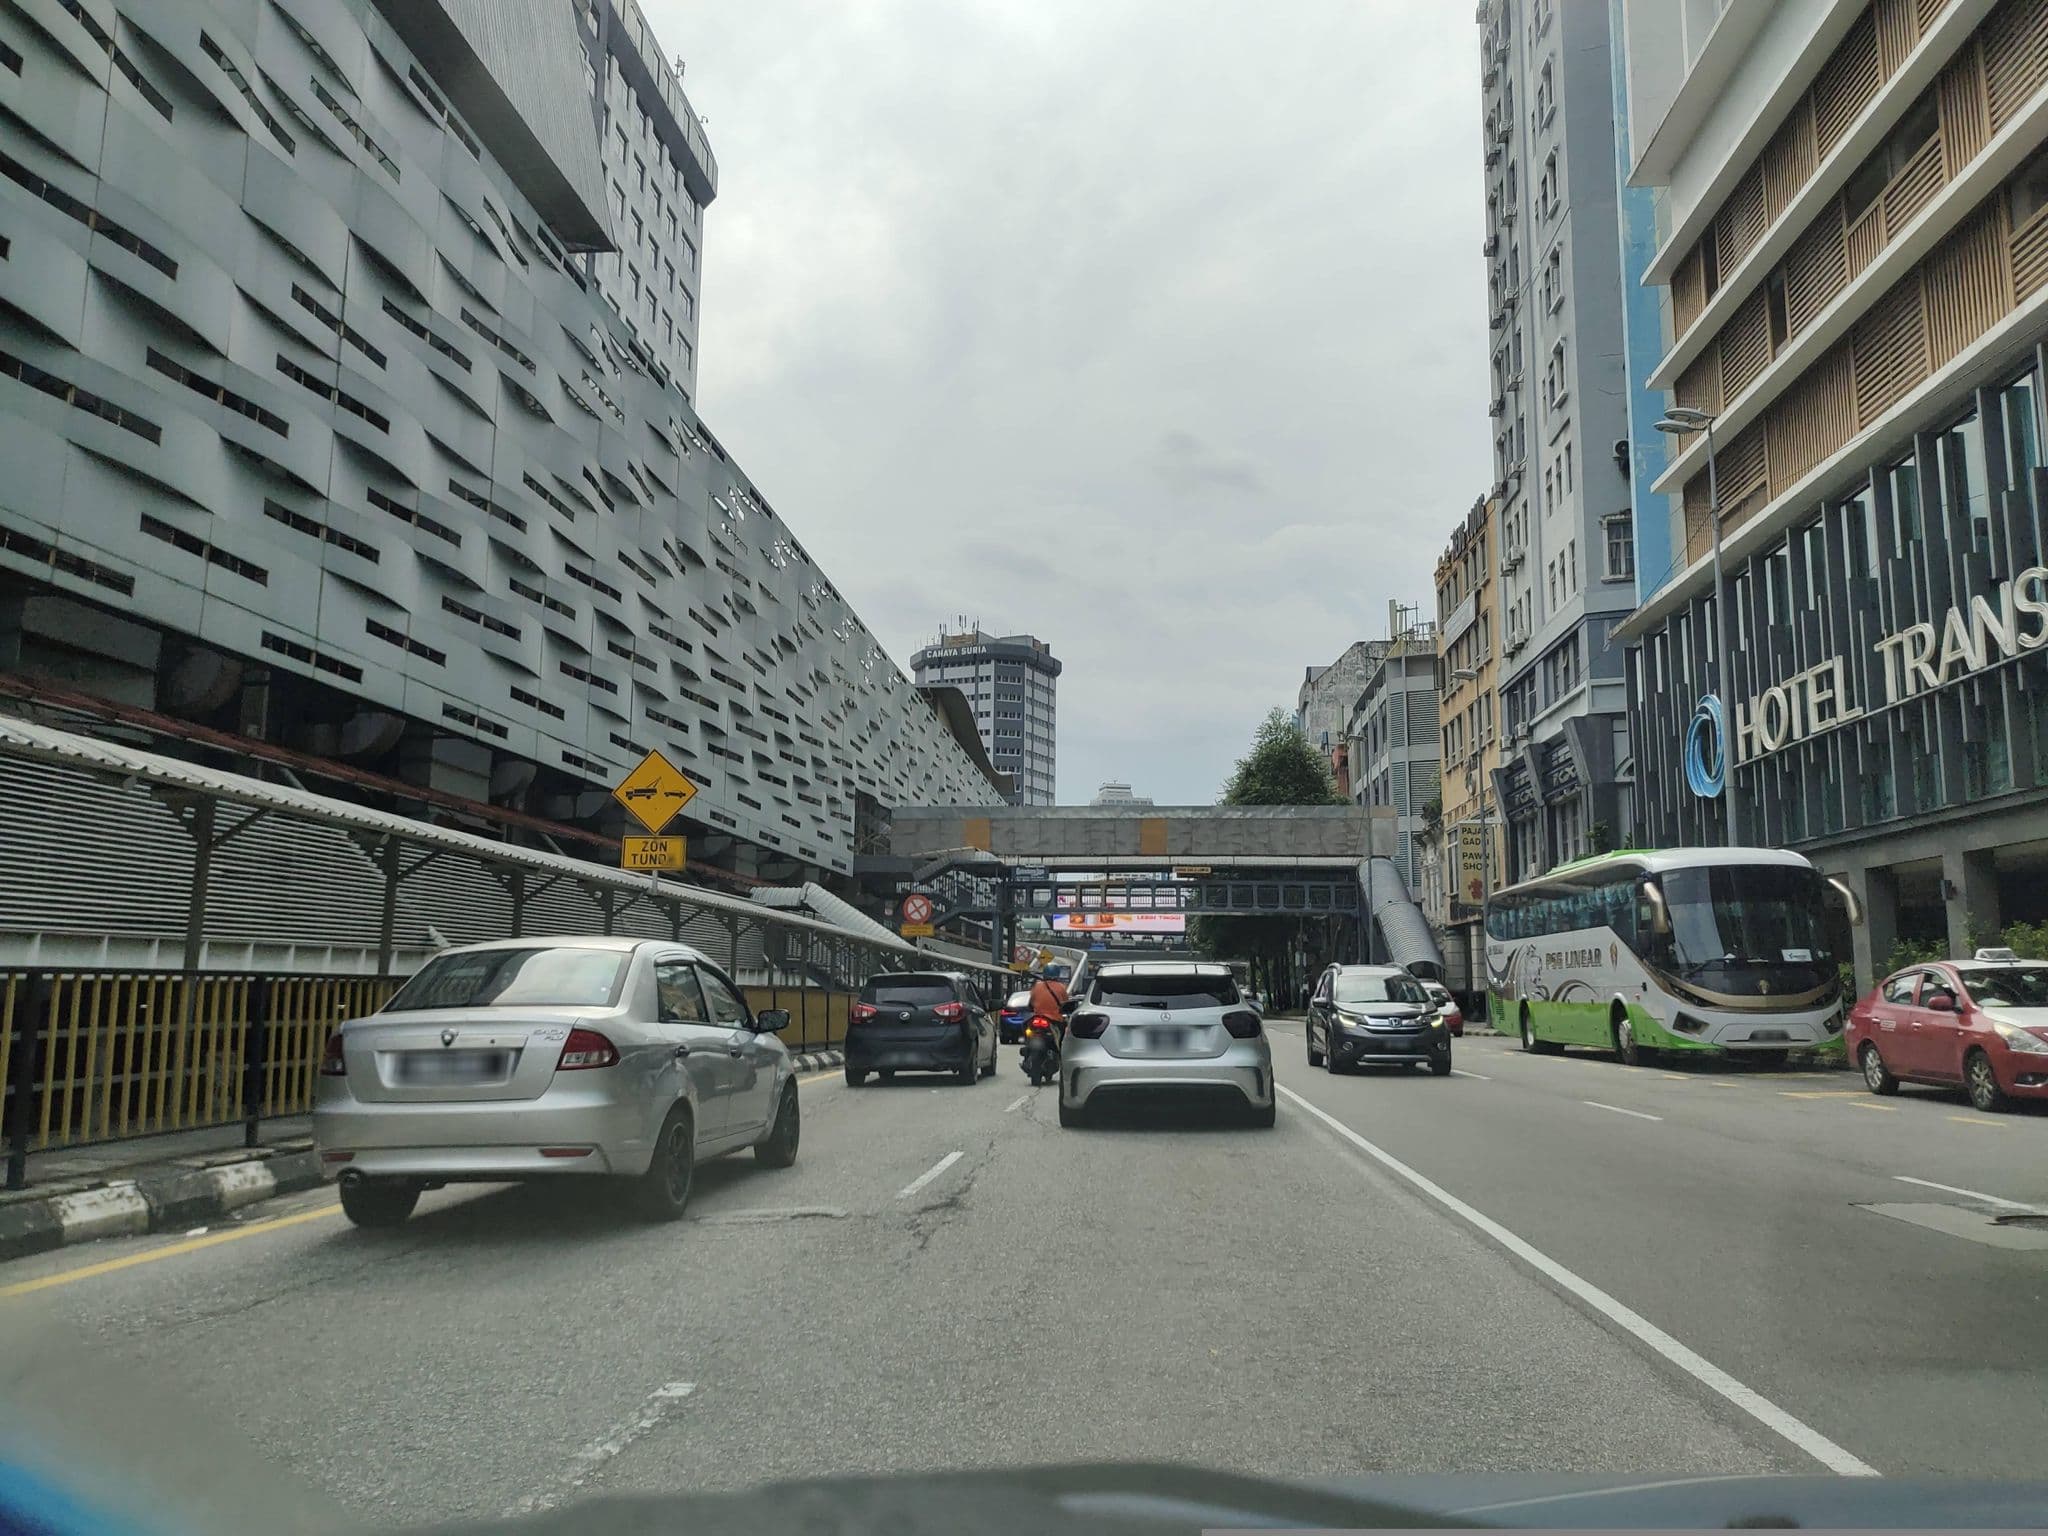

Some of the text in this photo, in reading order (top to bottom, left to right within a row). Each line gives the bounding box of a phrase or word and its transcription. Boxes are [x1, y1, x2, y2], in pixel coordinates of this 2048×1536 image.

[926, 645, 987, 659] CAHAYA SURIA
[1735, 566, 2048, 762] HOTEL TRANS
[641, 840, 668, 852] ZON
[1462, 837, 1490, 846] GADI
[631, 853, 675, 866] TUND
[1462, 851, 1490, 861] PAWN
[1463, 862, 1490, 871] SHOP
[1565, 948, 1602, 969] LINEAR
